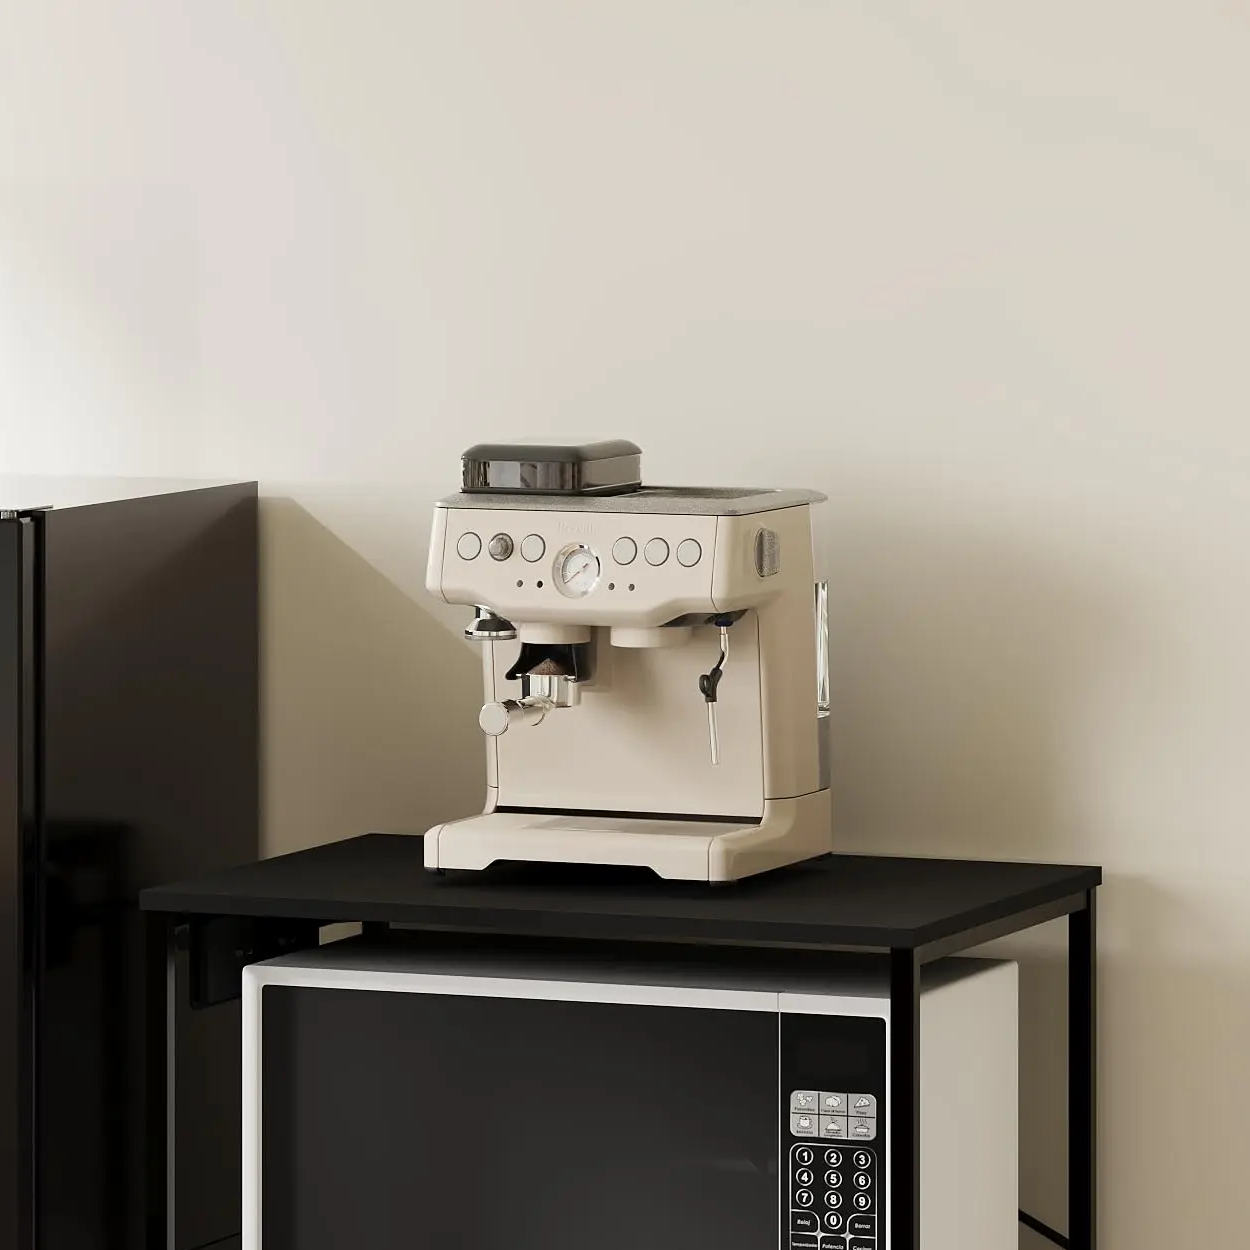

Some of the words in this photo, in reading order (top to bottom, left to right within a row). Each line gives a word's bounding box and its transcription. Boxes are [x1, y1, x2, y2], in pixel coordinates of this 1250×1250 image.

[802, 1151, 808, 1162] 1
[830, 1153, 837, 1163] 2
[858, 1154, 866, 1165] 3
[800, 1172, 808, 1182] 4
[830, 1174, 837, 1184] 5
[858, 1176, 866, 1186] 6
[801, 1192, 808, 1202] 7
[830, 1194, 837, 1204] 8
[858, 1196, 866, 1206] 9
[830, 1215, 837, 1226] 0
